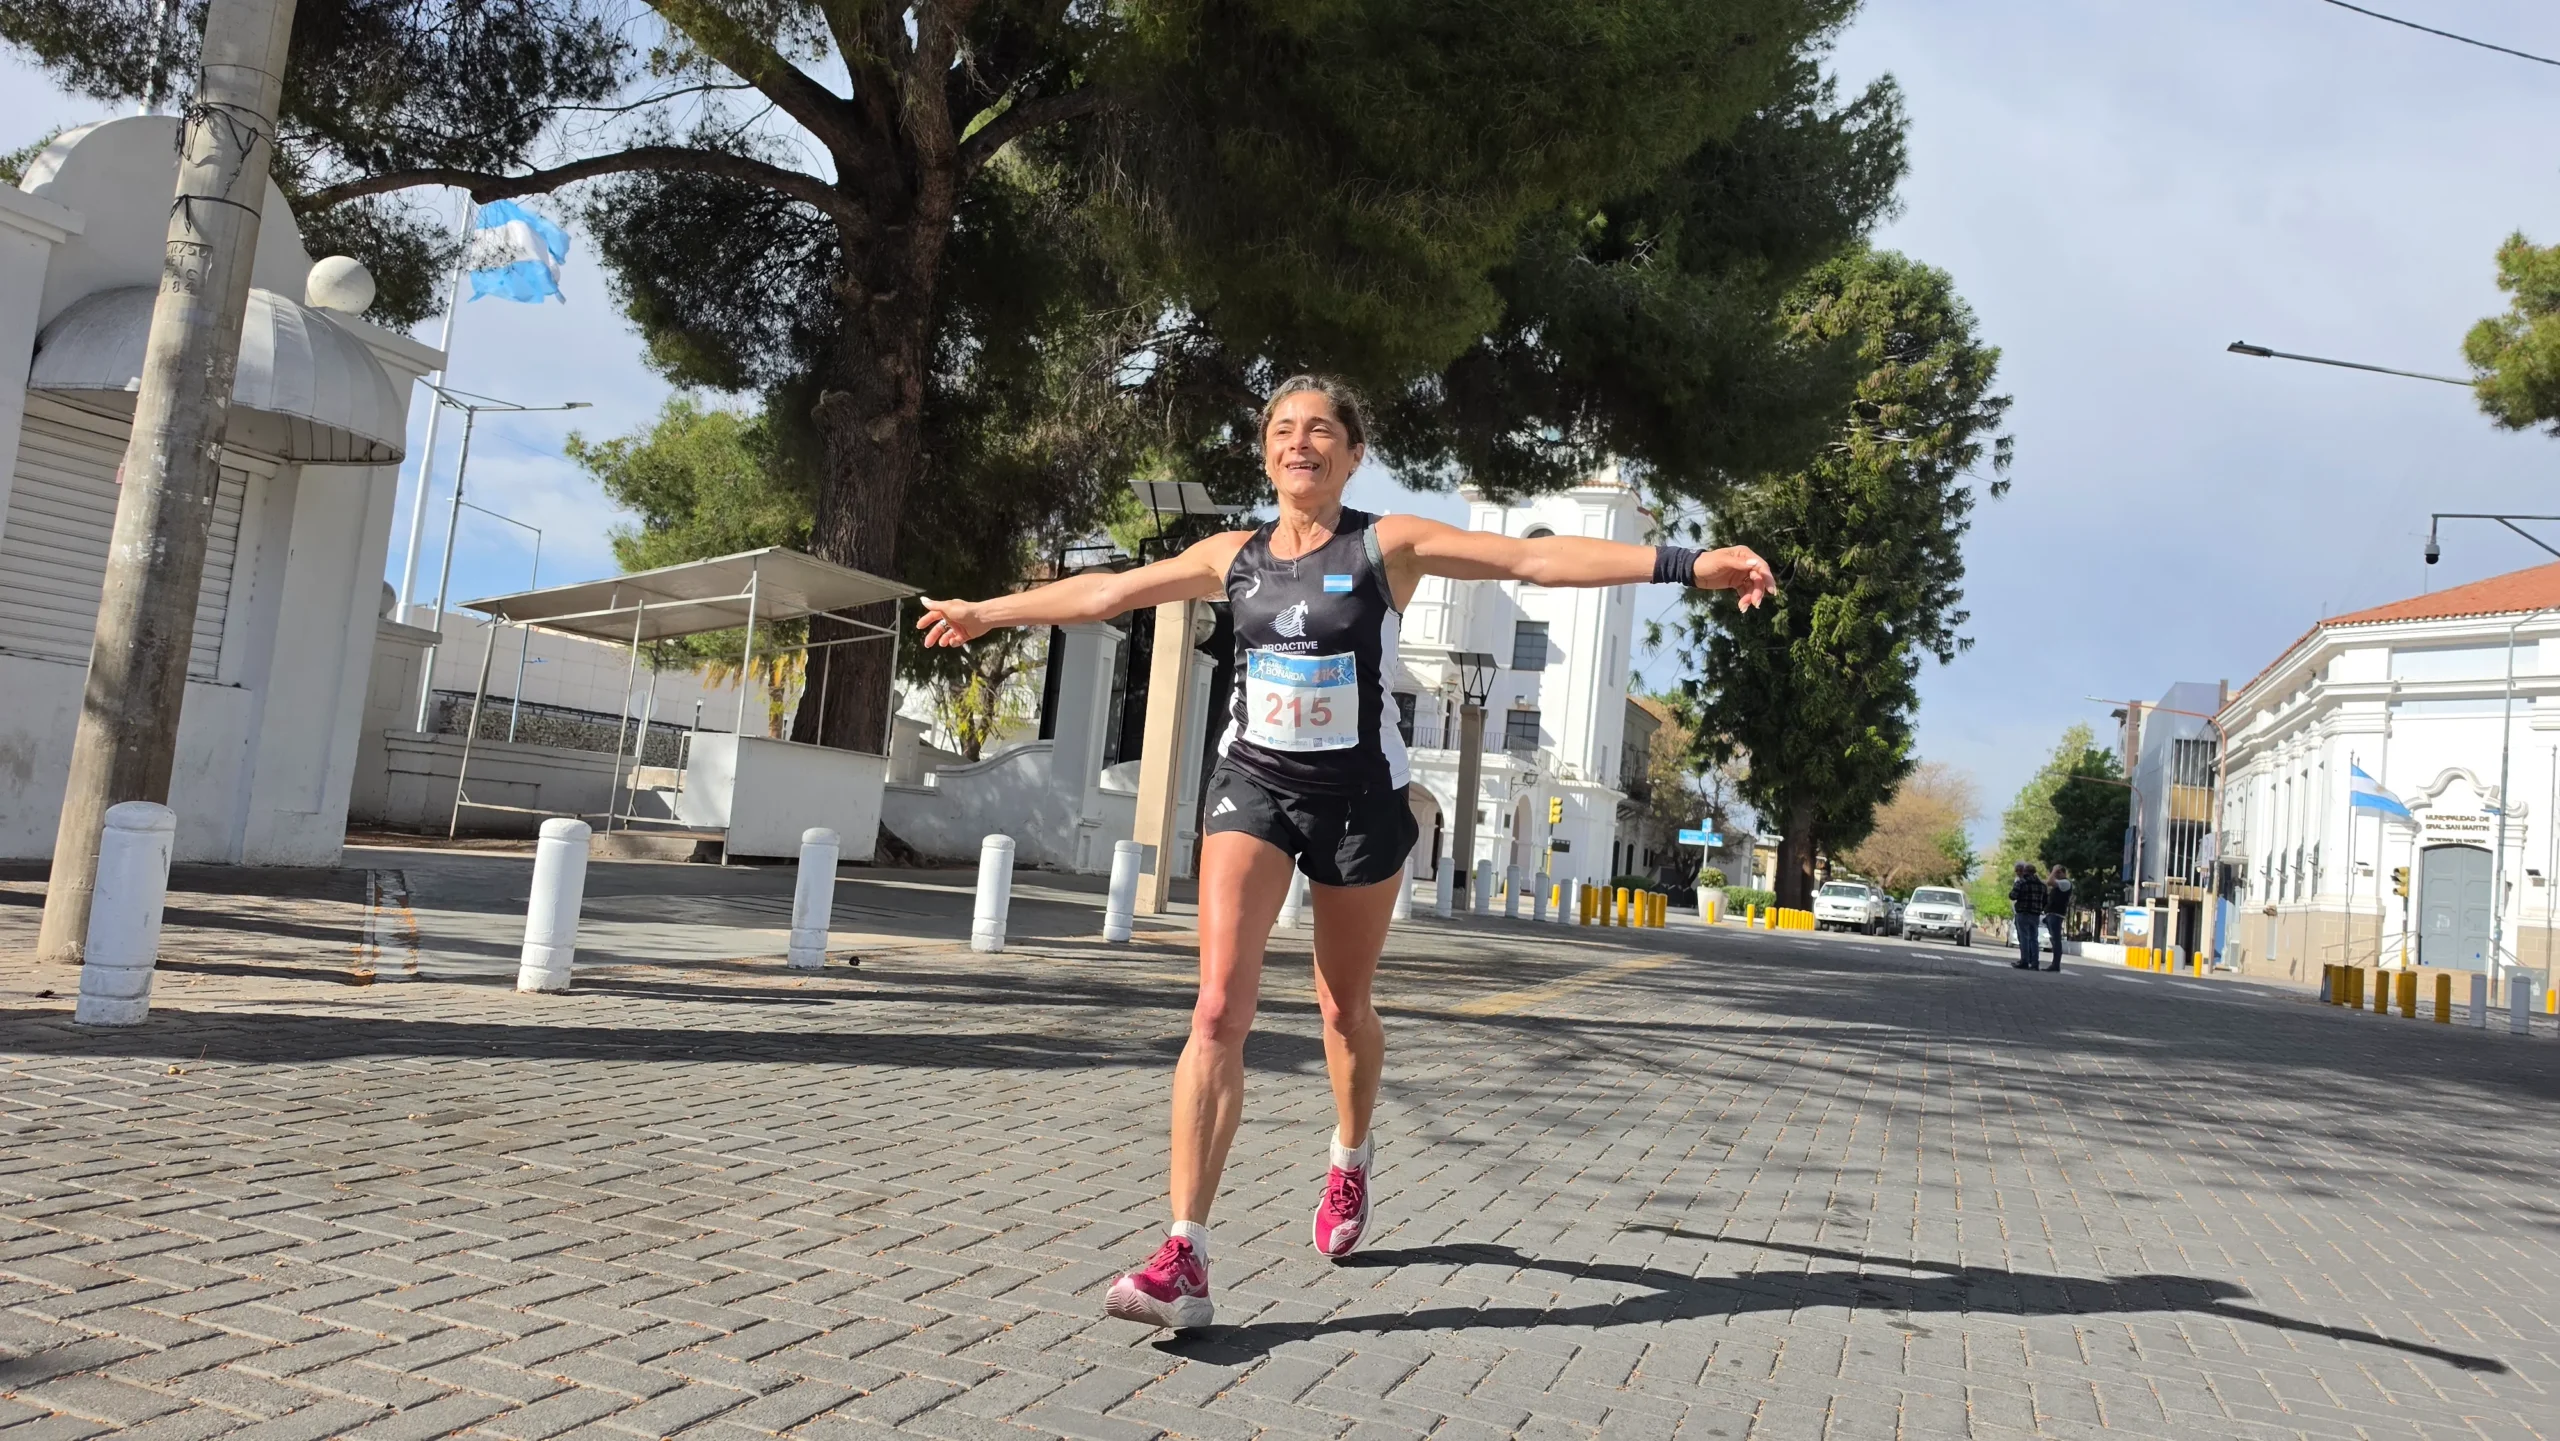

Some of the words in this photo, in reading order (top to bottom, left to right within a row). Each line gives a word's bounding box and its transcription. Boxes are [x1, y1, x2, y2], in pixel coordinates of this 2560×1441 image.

[1262, 641, 1318, 652] PROACTIVE
[1266, 666, 1306, 681] BONARDA
[1265, 692, 1332, 728] 215
